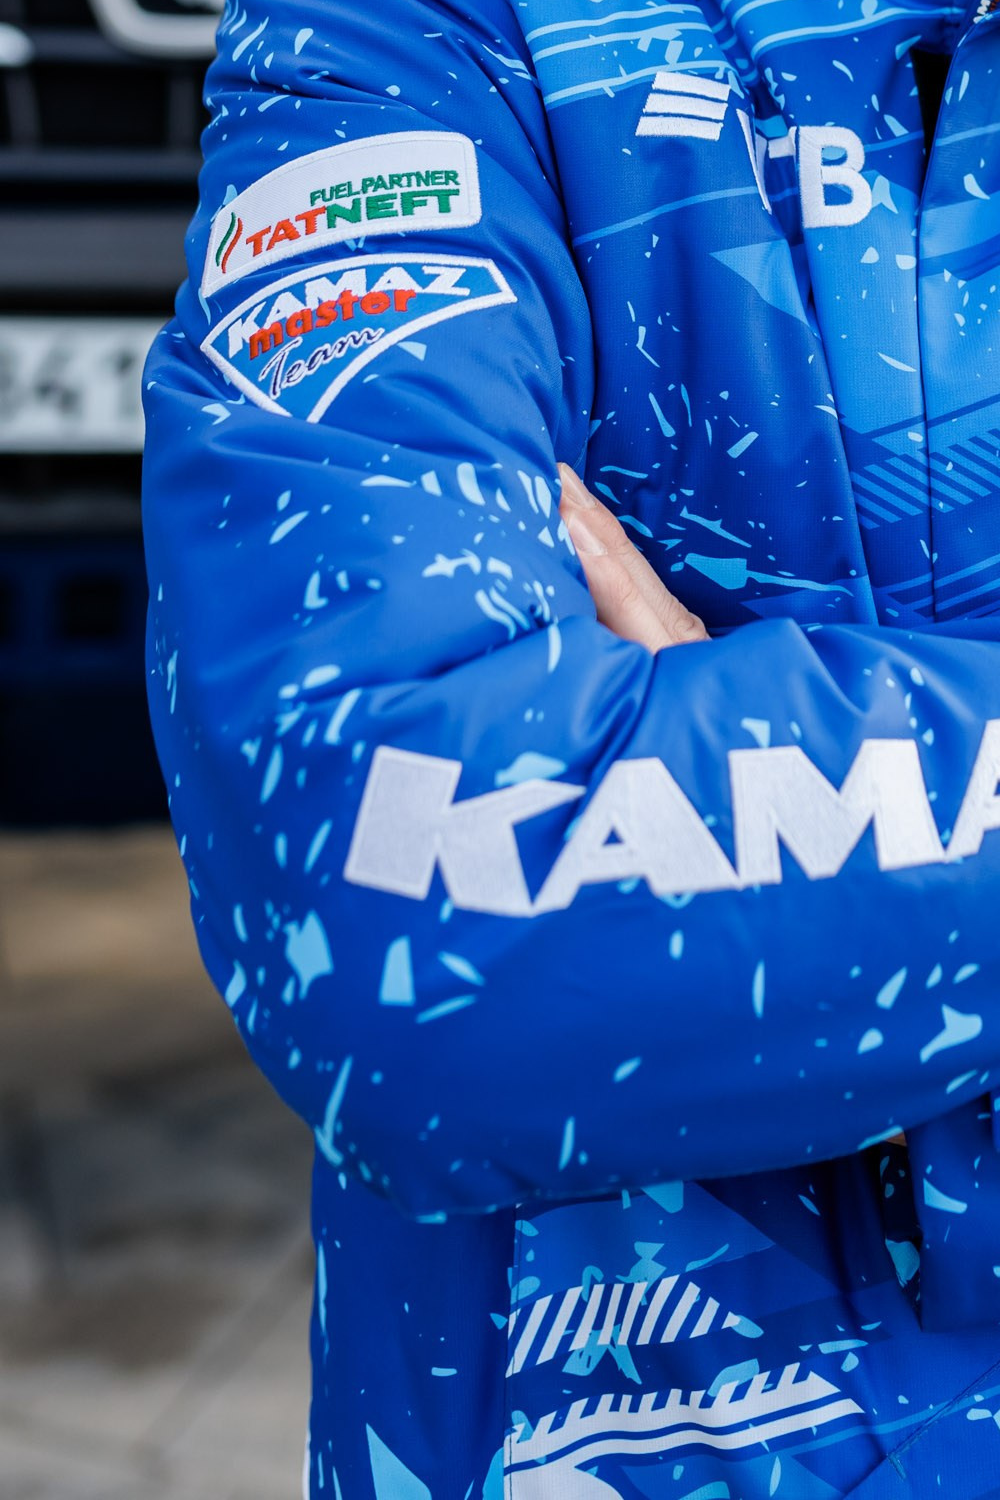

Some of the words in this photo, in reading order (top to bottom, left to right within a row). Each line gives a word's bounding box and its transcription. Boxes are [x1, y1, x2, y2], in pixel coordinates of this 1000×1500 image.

[245, 188, 461, 258] TATNEFT
[310, 180, 361, 207] FUEL
[362, 169, 461, 191] PARTNER
[227, 265, 471, 359] KAMAZ
[249, 288, 418, 361] master
[258, 326, 385, 399] Team
